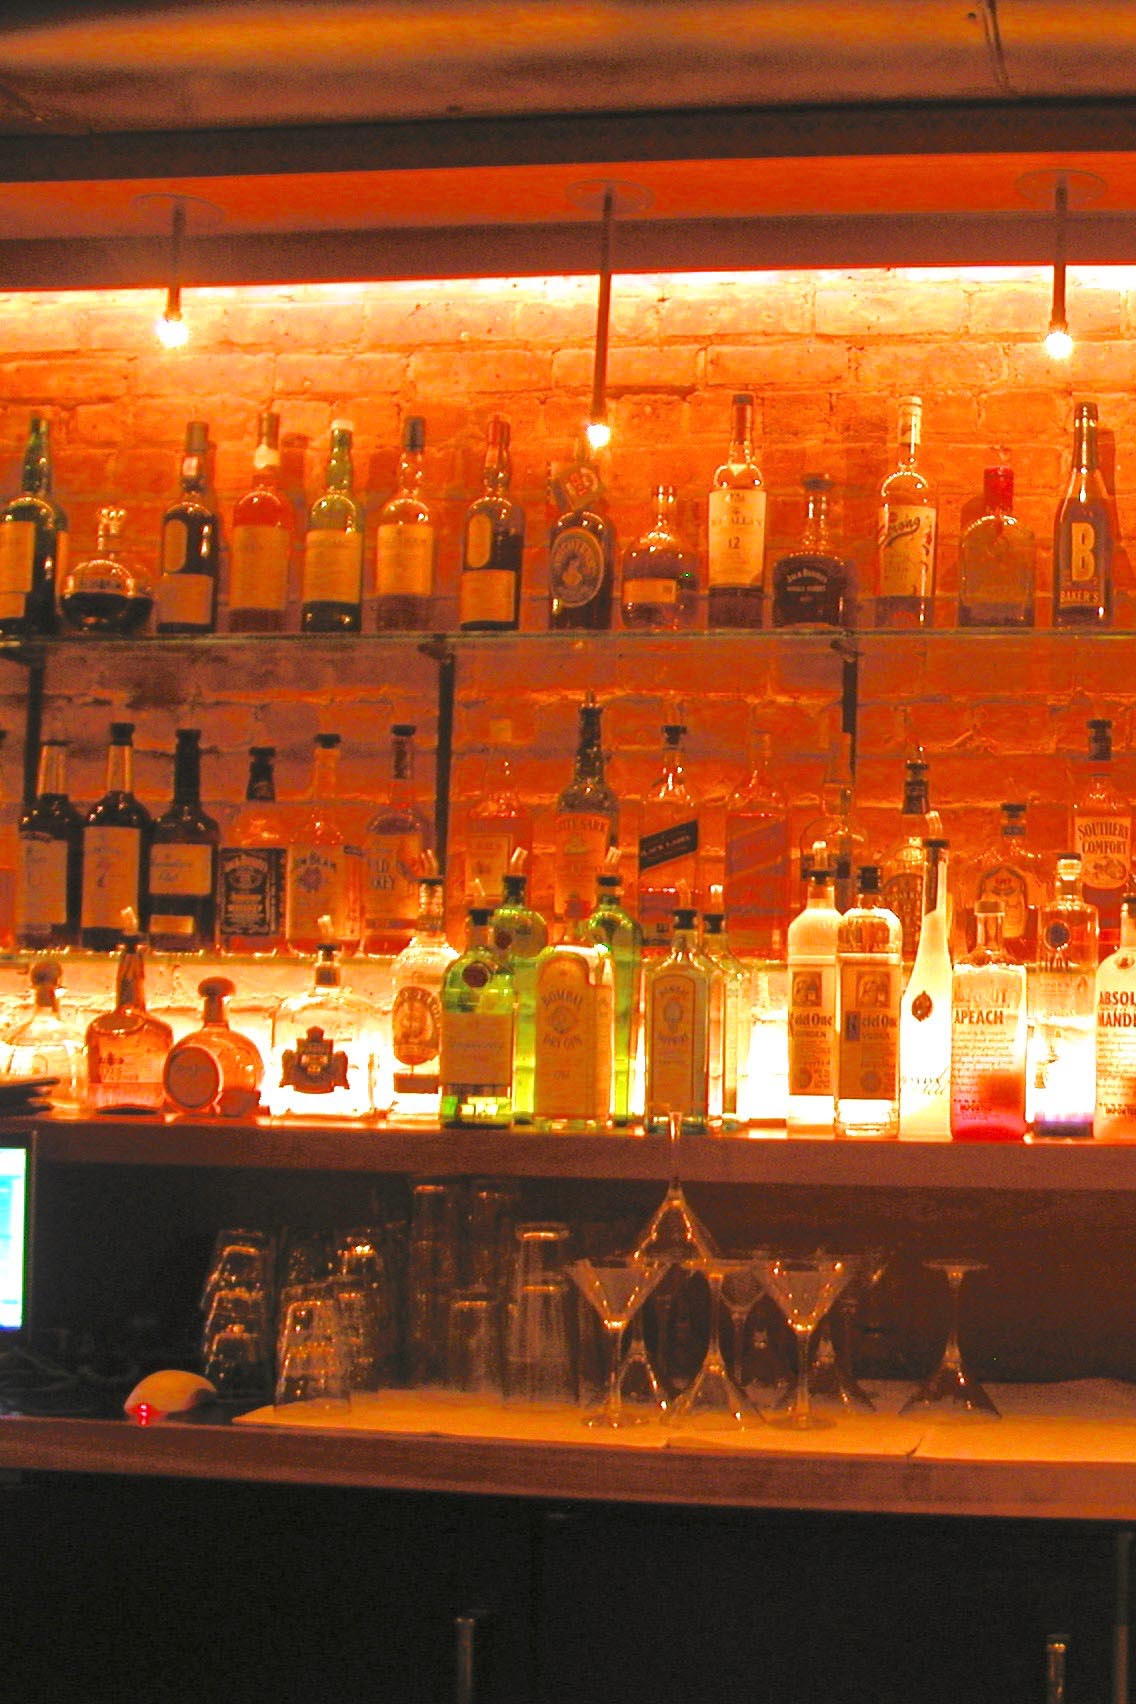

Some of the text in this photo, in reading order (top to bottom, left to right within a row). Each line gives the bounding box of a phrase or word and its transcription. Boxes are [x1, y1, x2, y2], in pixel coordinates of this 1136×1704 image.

[1071, 522, 1096, 582] B
[1059, 589, 1100, 604] BAKER'S
[1081, 842, 1127, 855] COMFORT
[954, 1009, 1004, 1025] APEACH
